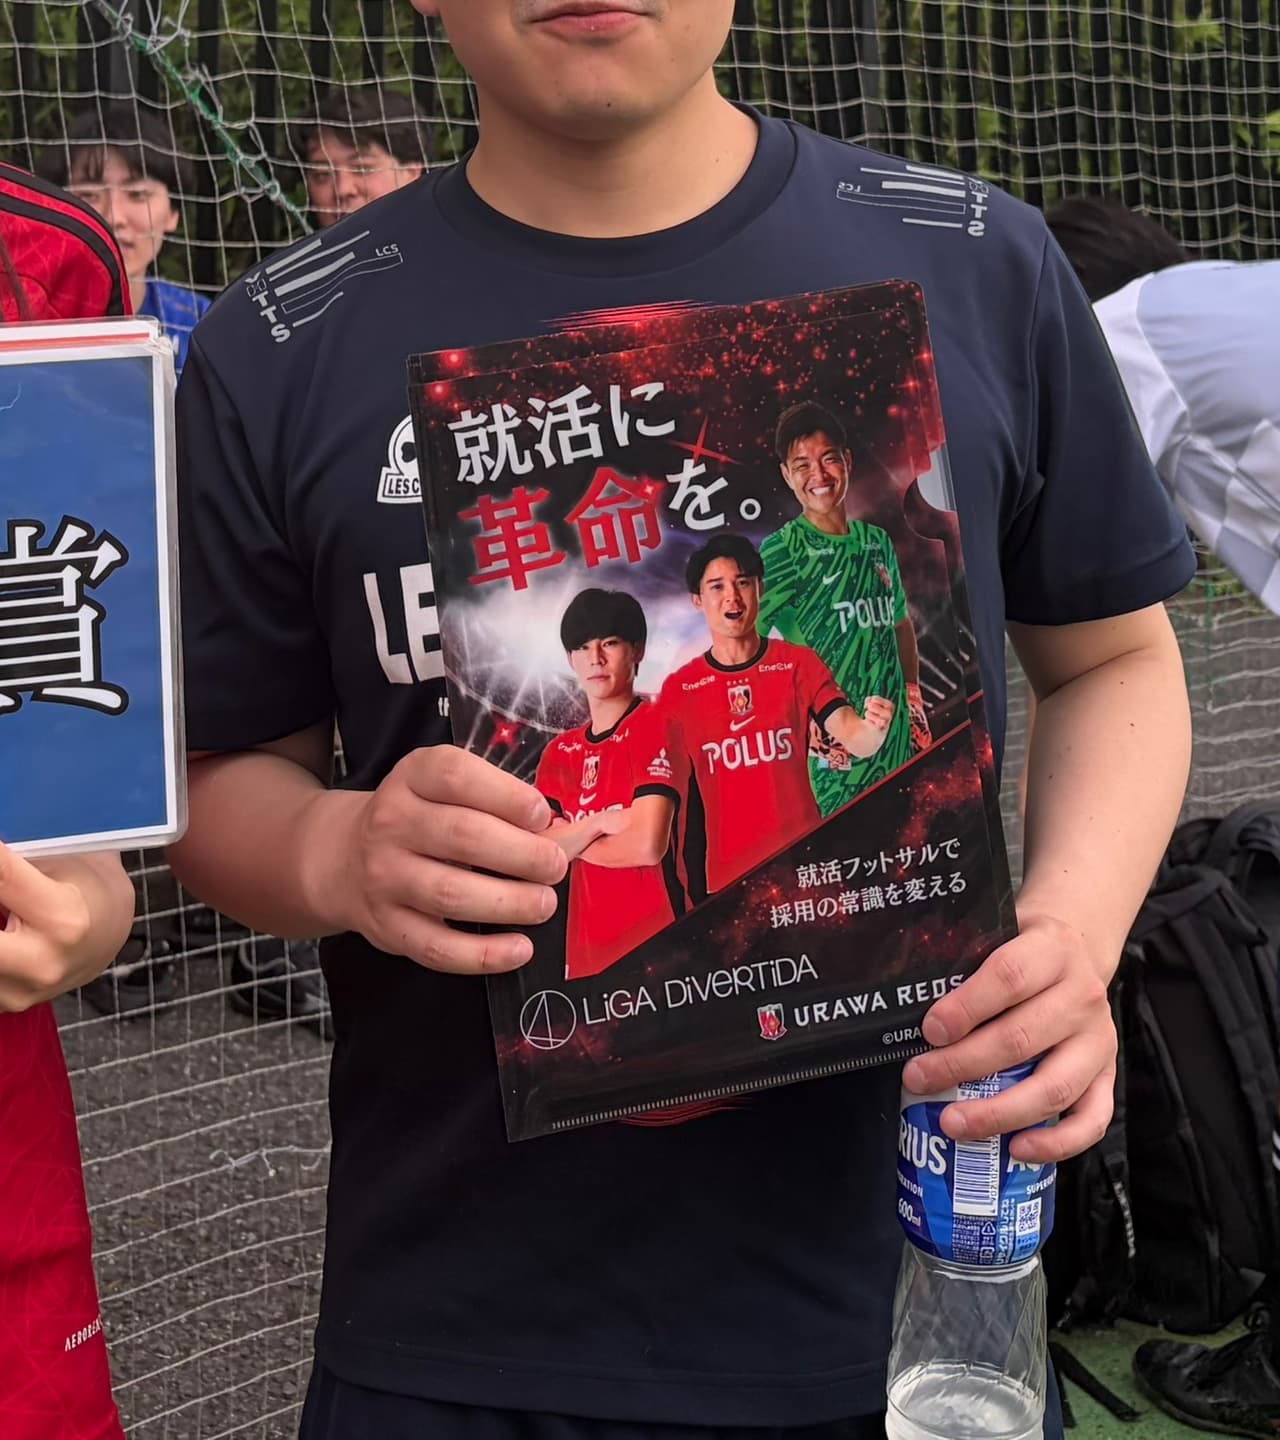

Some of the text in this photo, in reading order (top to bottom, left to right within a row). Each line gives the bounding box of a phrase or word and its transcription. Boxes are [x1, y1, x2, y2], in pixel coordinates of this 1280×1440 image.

[375, 243, 400, 258] LCS
[449, 381, 676, 485] 就活に
[387, 478, 410, 494] LES
[363, 563, 445, 684] LE
[702, 727, 792, 774] POLUS
[796, 838, 961, 888] 就活フットサルで
[770, 871, 967, 928] 採用の常識を変える
[794, 991, 888, 1027] URAWA
